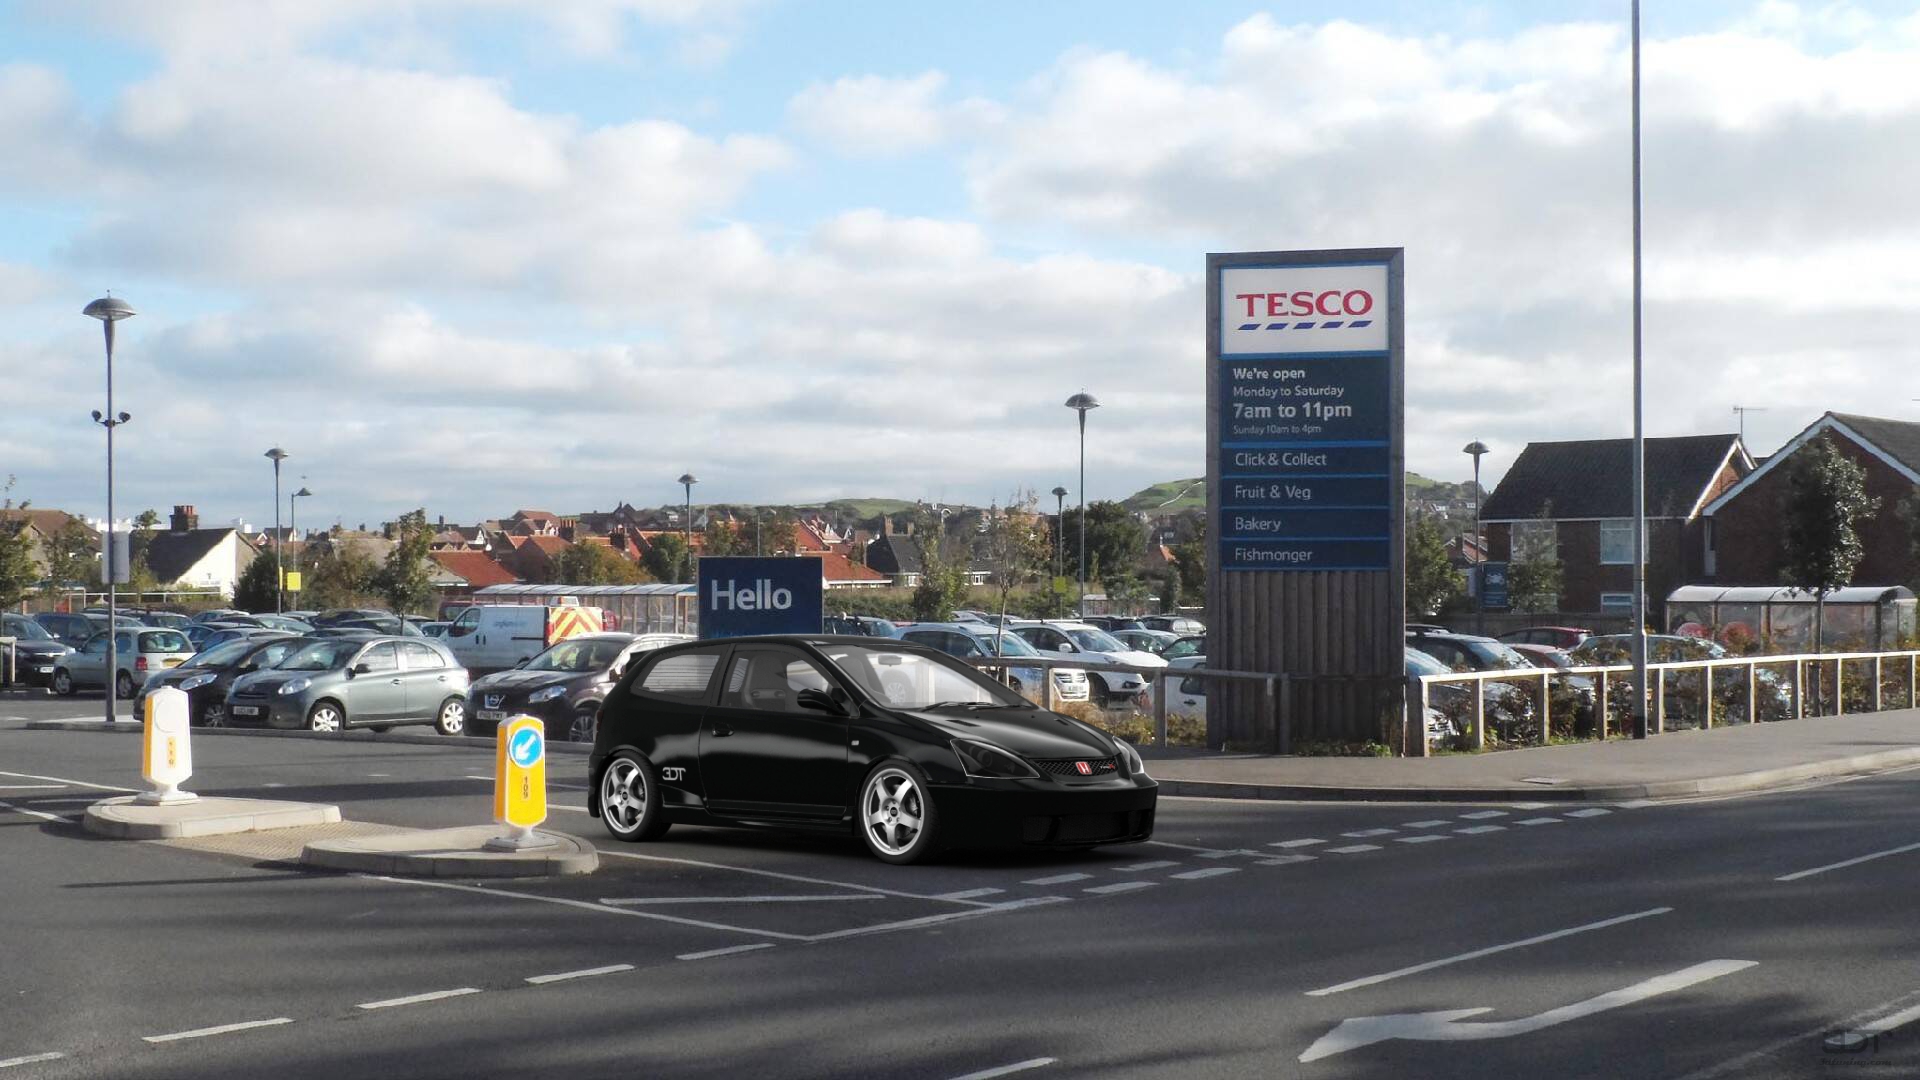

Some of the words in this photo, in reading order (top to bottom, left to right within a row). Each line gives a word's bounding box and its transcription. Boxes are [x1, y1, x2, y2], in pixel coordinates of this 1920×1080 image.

[1235, 289, 1373, 317] TESCO
[1233, 367, 1269, 380] We're
[1272, 369, 1306, 382] open
[1233, 386, 1278, 398] Monday
[1280, 387, 1292, 396] to
[1294, 385, 1344, 398] Saturday
[1233, 403, 1271, 418] 7am
[1278, 403, 1297, 418] to
[1302, 402, 1352, 421] 11pm
[1233, 425, 1264, 436] Sunday
[1266, 424, 1290, 433] 10am
[1291, 424, 1300, 433] to
[1302, 424, 1322, 435] 4pm
[1234, 453, 1266, 466] Click
[1267, 453, 1279, 465] &
[1282, 452, 1327, 466] Collect
[1234, 485, 1266, 498] Fruit
[1270, 485, 1281, 498] &
[1284, 485, 1311, 500] Veg
[1234, 516, 1281, 532] Bakery
[1234, 547, 1313, 563] Fishmonger
[711, 579, 792, 611] Hello
